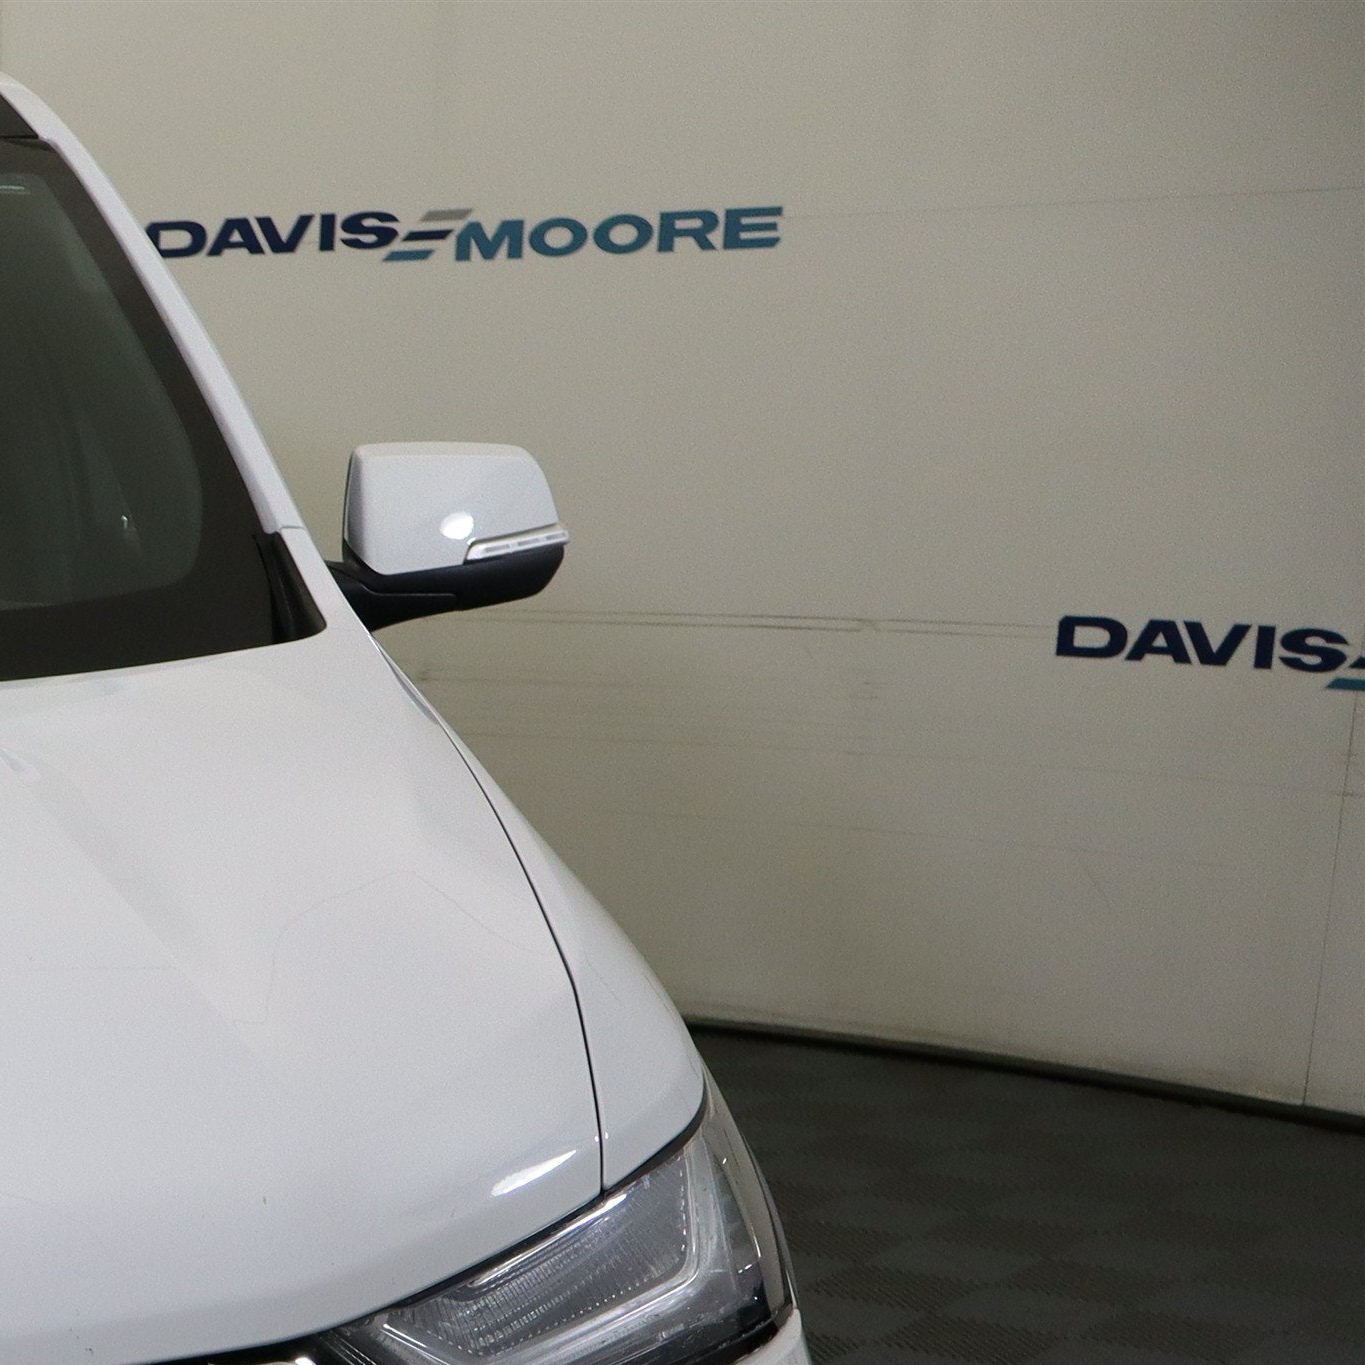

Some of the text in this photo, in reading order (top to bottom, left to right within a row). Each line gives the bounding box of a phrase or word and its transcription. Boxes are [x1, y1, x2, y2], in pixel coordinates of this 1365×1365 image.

[145, 206, 784, 261] DAVIS MOORE
[1055, 615, 1349, 673] DAVIS
